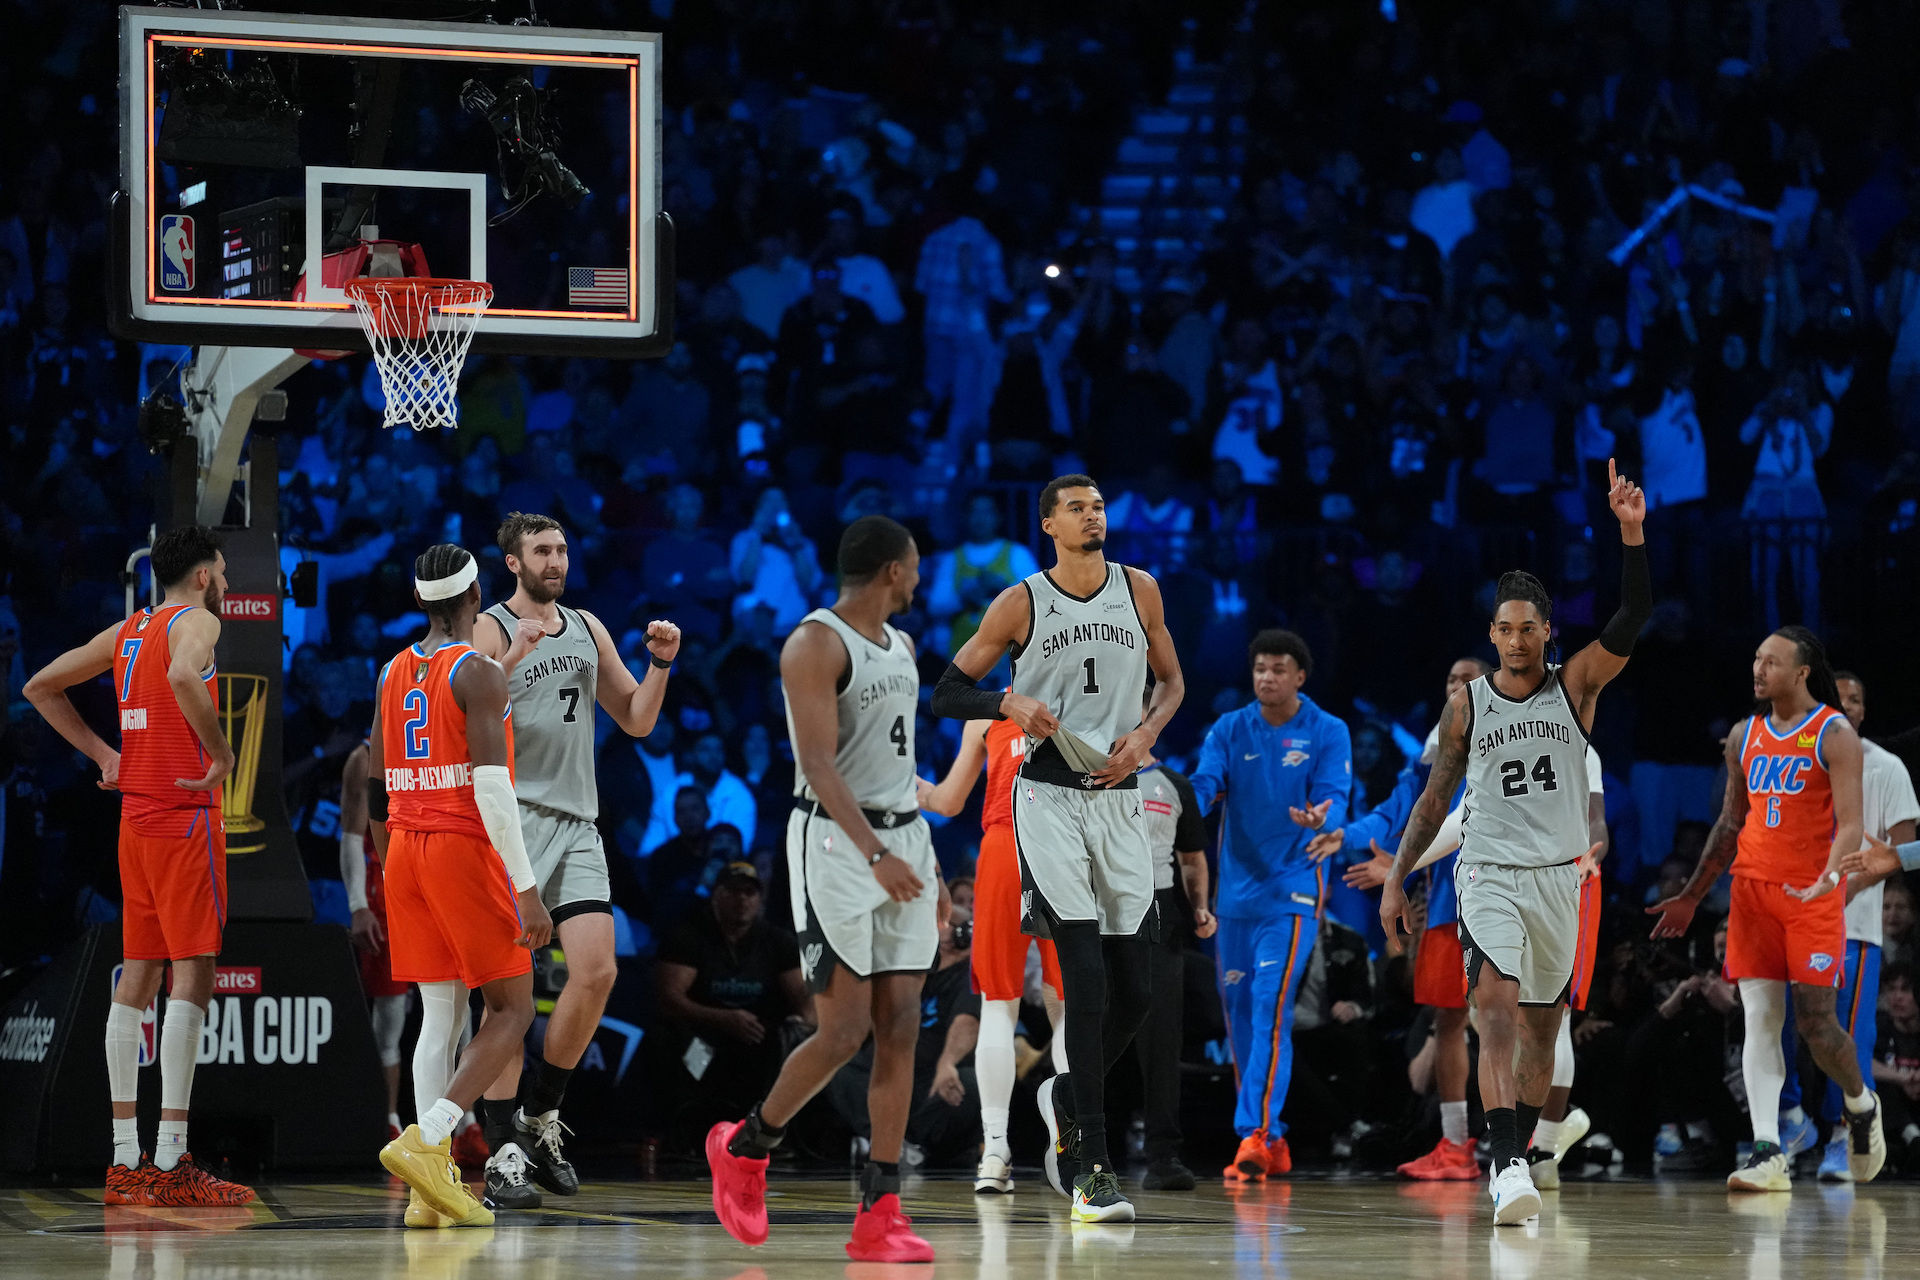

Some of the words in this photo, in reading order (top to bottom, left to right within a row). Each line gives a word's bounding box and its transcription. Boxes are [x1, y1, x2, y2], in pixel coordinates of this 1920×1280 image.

[165, 273, 183, 286] NBA
[220, 599, 271, 617] irates
[1042, 628, 1069, 659] SAN
[1073, 623, 1135, 650] ANTONIO
[120, 637, 144, 703] 7
[524, 660, 550, 689] SAN
[1082, 657, 1100, 694] 1
[559, 687, 580, 723] 7
[860, 679, 887, 710] SAN
[402, 687, 431, 761] 2
[890, 714, 907, 757] 4
[1478, 727, 1505, 758] SAN
[1508, 720, 1570, 745] ANTONIO
[1499, 754, 1558, 798] 24
[1747, 754, 1814, 796] OKC
[1765, 796, 1781, 828] 6
[214, 971, 256, 989] rates
[194, 995, 246, 1065] BA
[252, 995, 333, 1065] CUP
